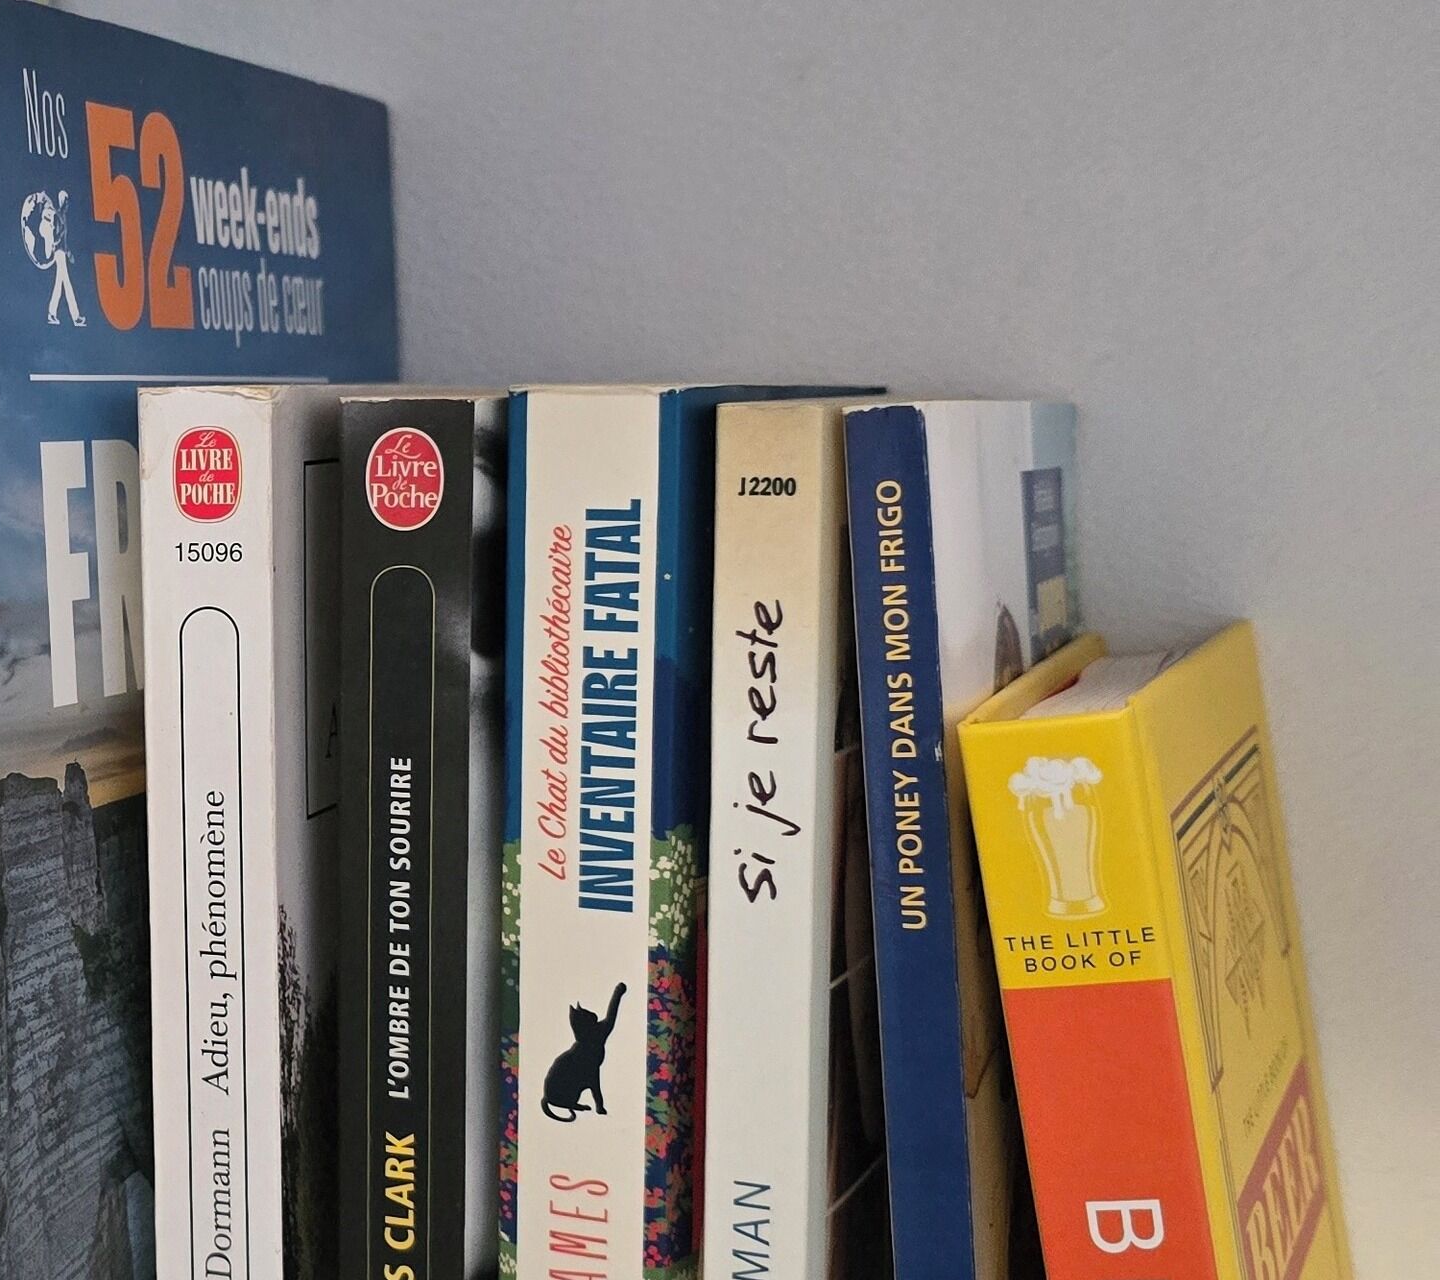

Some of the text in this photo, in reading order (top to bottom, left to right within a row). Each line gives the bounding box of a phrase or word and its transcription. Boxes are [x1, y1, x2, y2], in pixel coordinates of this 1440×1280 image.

[22, 67, 196, 332] Nos 52
[189, 166, 321, 261] week-ends
[198, 264, 253, 349] coups
[257, 259, 280, 333] de
[179, 448, 233, 471] LIVRE
[195, 431, 217, 448] Le
[374, 455, 438, 478] Livre
[384, 434, 422, 459] Le
[179, 483, 236, 506] POCHE
[198, 470, 215, 482] de
[371, 483, 439, 509] Poche
[392, 474, 408, 491] de
[175, 542, 243, 563] 15096
[735, 599, 784, 745] reste
[537, 524, 573, 882] Le Chat du bibliothécaire
[578, 498, 642, 913] INVENTAIRE FATAL
[875, 479, 927, 931] UN PONEY DANS MON FRIGO
[389, 756, 412, 872] SOURIRE
[732, 770, 802, 838] je
[199, 790, 237, 981] phénomène
[388, 880, 411, 933] TON
[388, 942, 411, 977] DE
[1004, 926, 1157, 953] THE LITTLE
[1024, 950, 1143, 973] BOOK OF
[200, 990, 234, 1096] Adieu,
[388, 984, 411, 1100] L'OMBRE
[384, 1131, 416, 1251] CLARK
